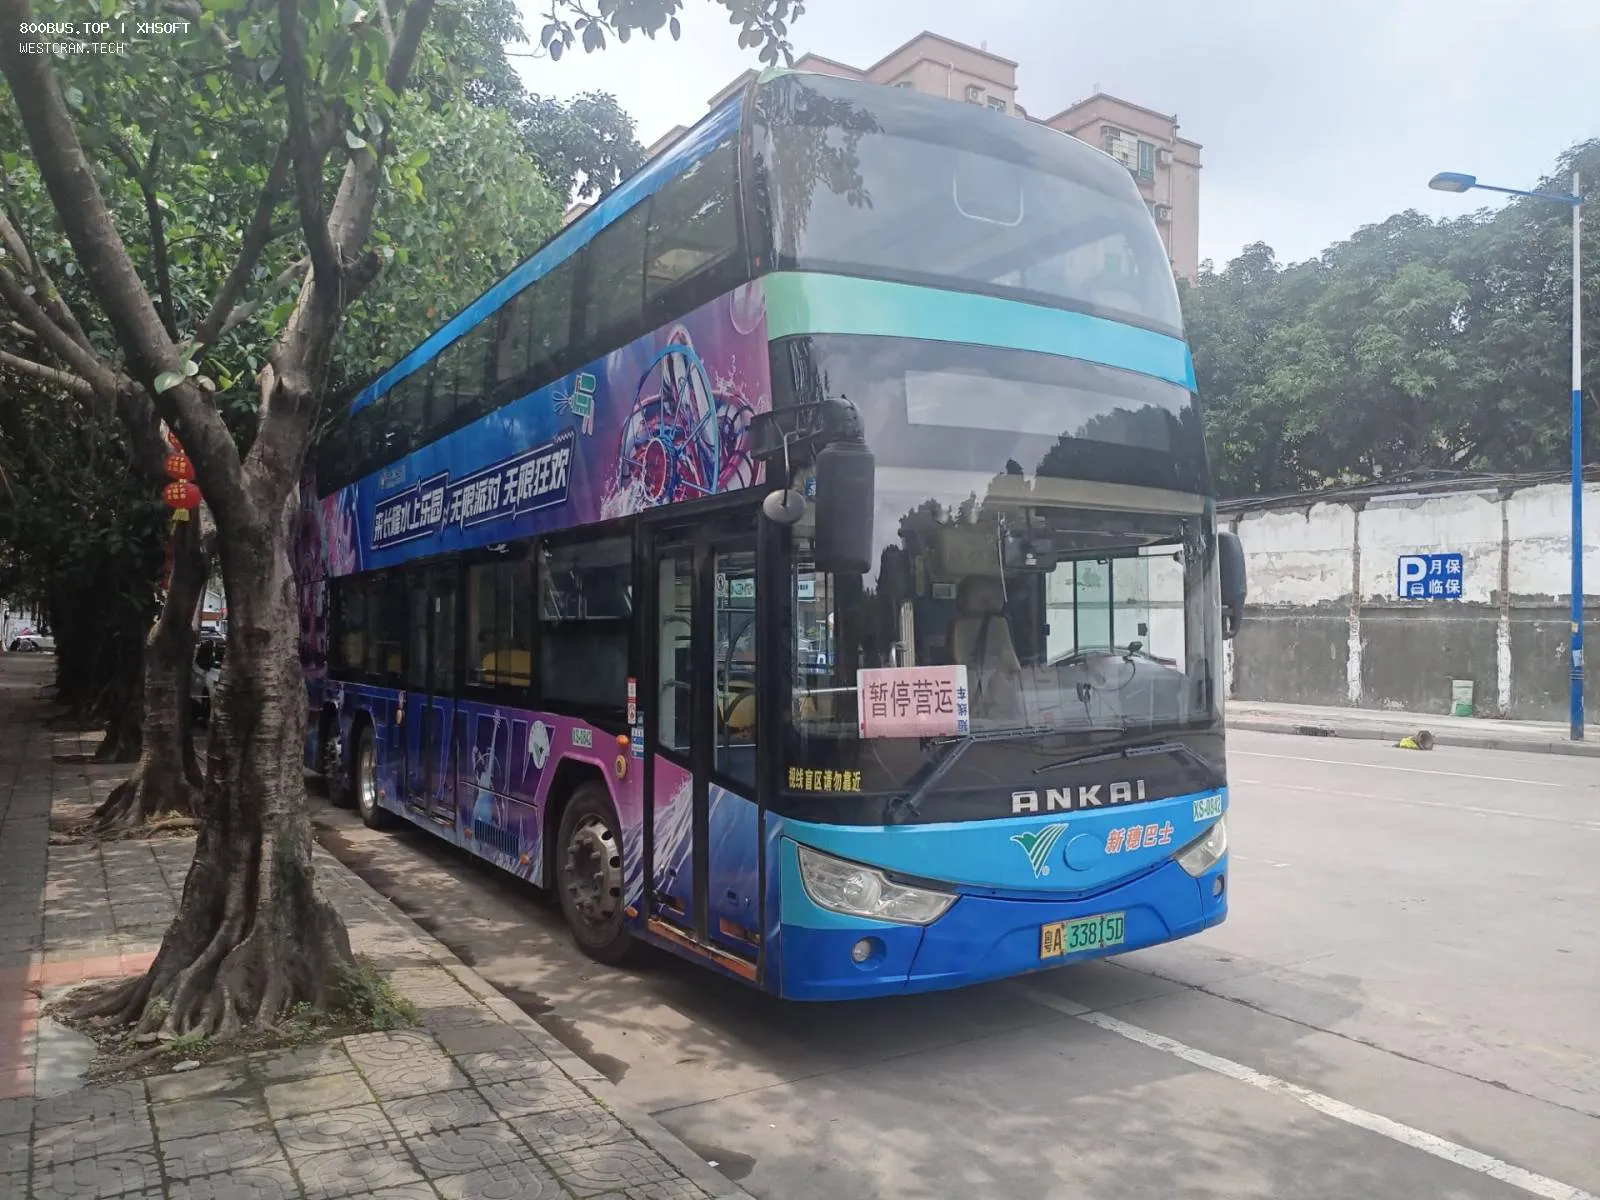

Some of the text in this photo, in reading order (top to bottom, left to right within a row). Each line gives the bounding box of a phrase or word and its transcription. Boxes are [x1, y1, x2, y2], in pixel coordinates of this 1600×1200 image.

[373, 486, 444, 541] 来长隆水上乐园
[450, 473, 501, 526] 无限派对
[502, 447, 570, 507] 无限狂欢
[1429, 559, 1460, 575] 月保
[1429, 579, 1460, 594] 临保
[869, 680, 954, 718] 暂停营运
[788, 767, 862, 792] 视线盲区请勿靠近
[1011, 780, 1146, 813] ANKAI
[1104, 820, 1174, 854] 新穗巴士
